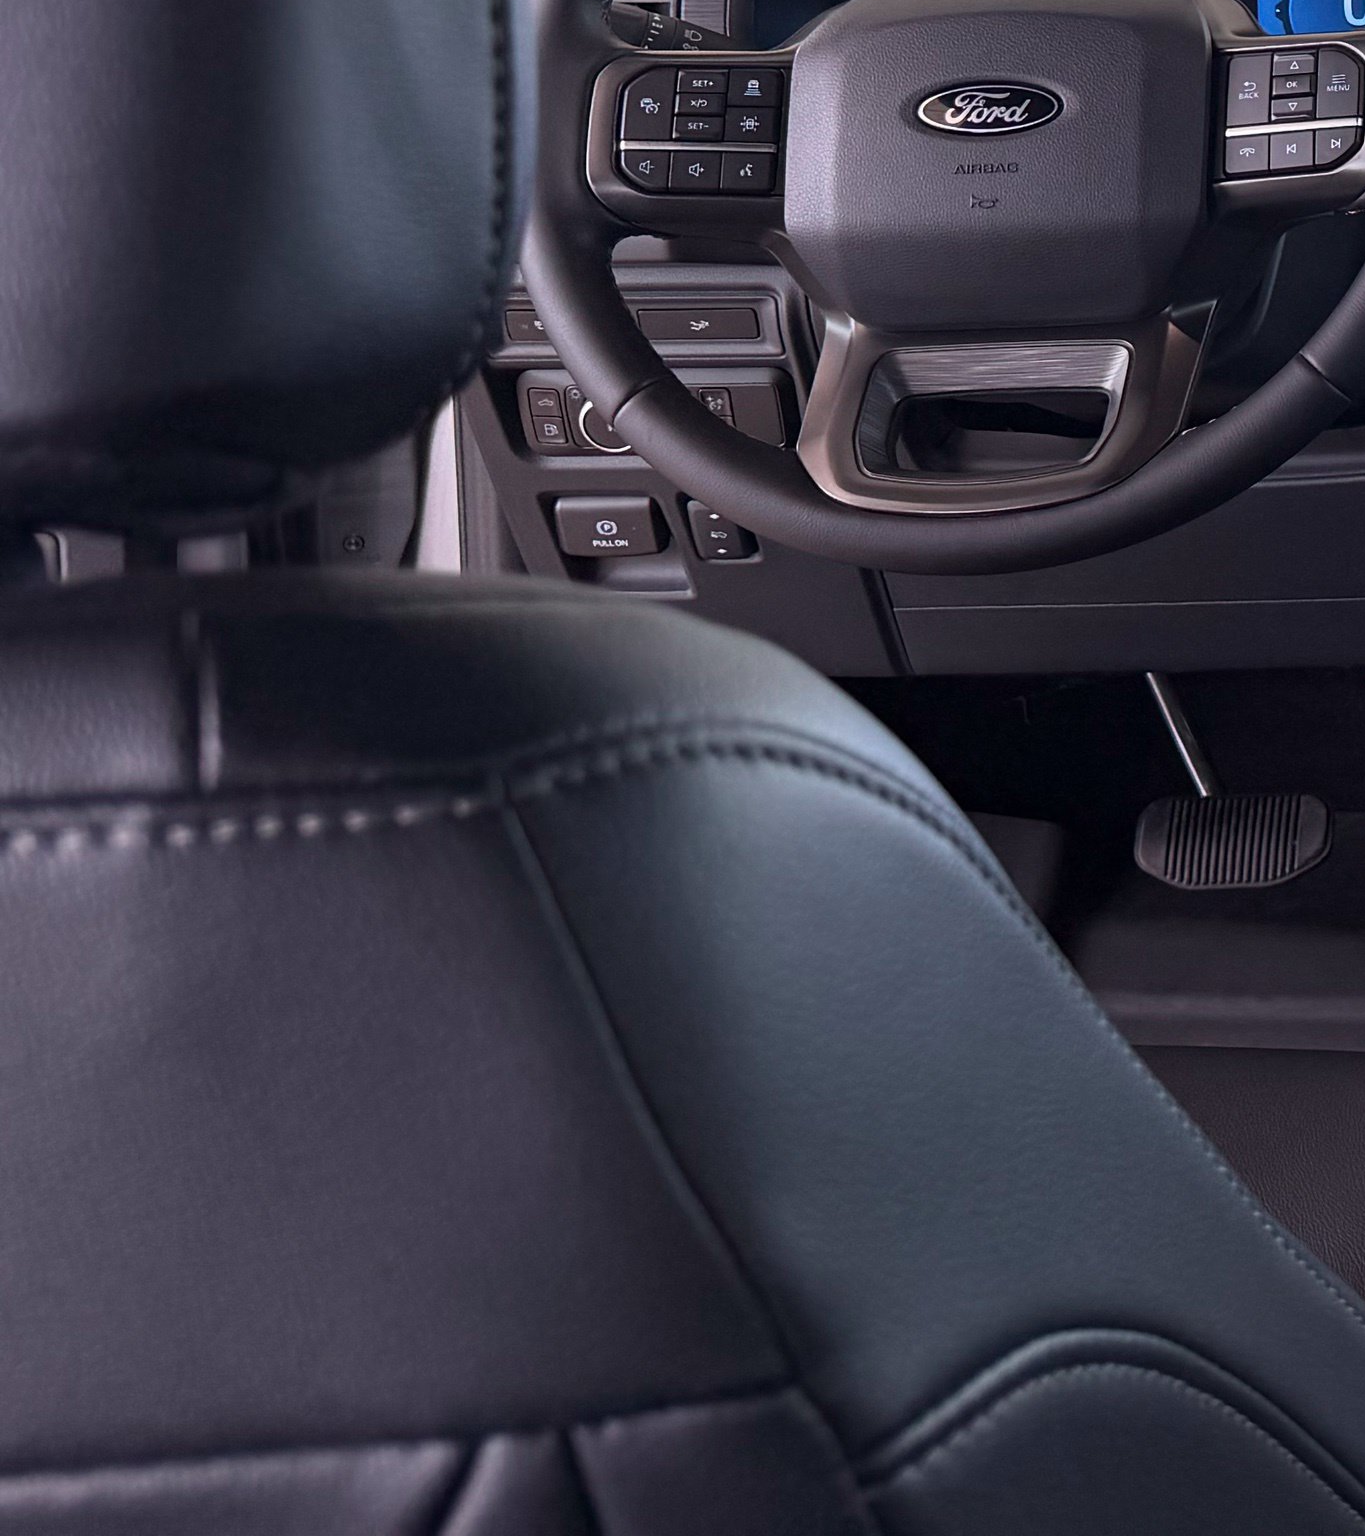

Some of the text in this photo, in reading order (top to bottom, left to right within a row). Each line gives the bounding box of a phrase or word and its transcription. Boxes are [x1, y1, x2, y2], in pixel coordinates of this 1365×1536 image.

[1286, 80, 1298, 89] OK
[1326, 84, 1350, 92] MENU
[1238, 92, 1259, 100] BACK
[944, 91, 1031, 125] Ford
[954, 162, 1019, 175] AIRBAG
[614, 539, 629, 547] ON
